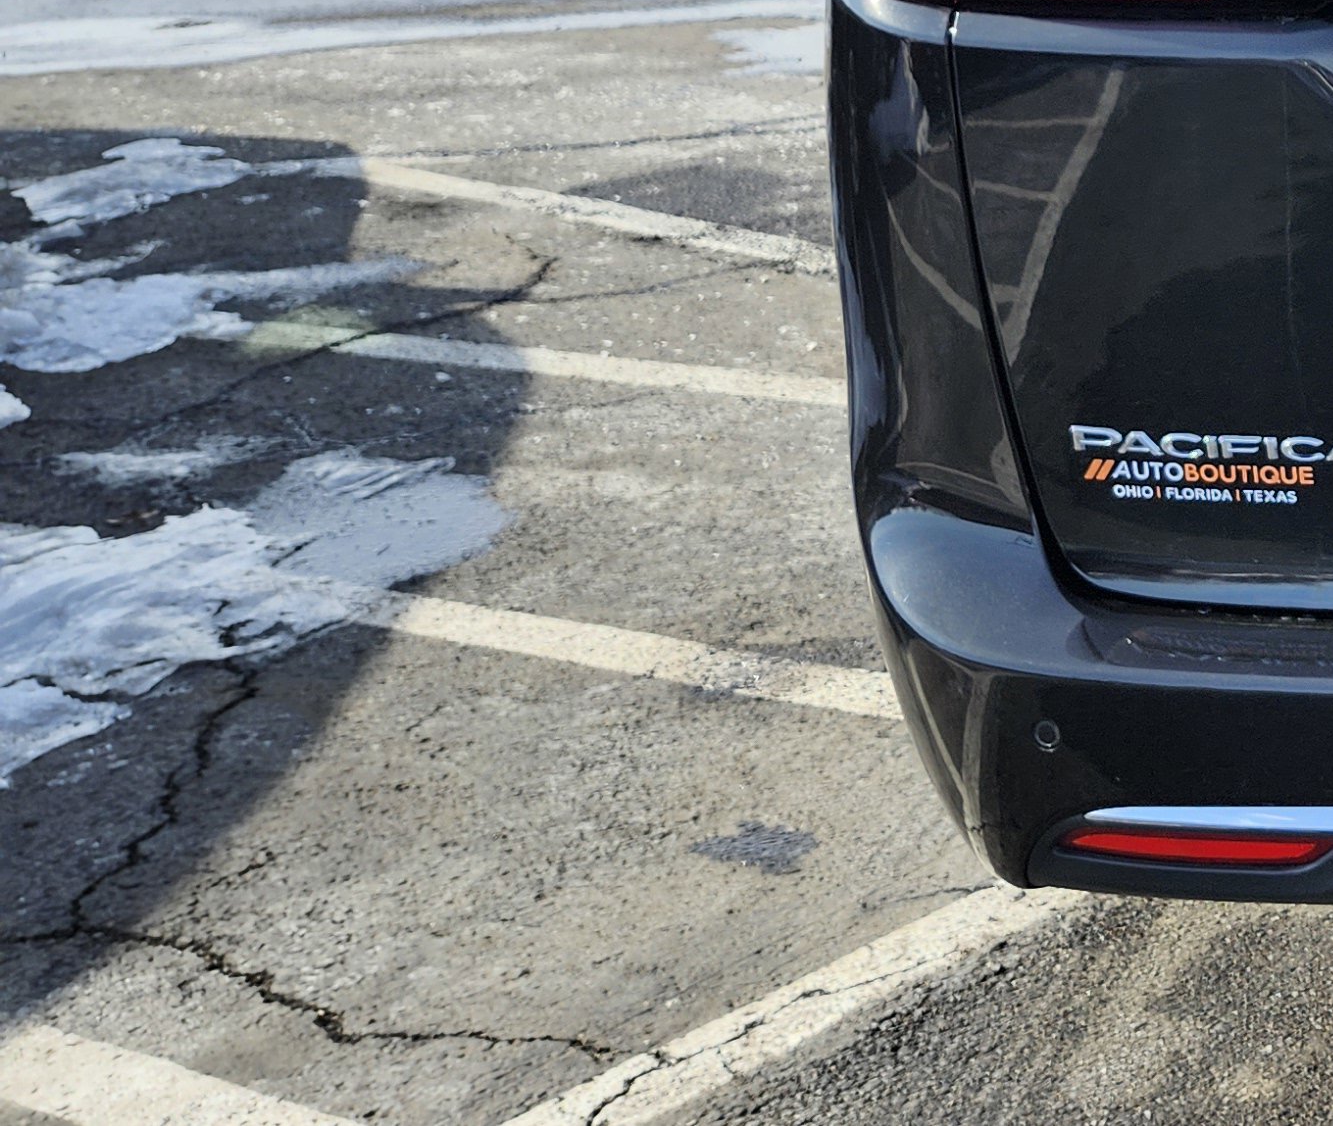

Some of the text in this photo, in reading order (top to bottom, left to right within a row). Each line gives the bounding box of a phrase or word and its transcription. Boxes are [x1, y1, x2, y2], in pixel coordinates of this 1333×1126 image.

[1112, 459, 1315, 486] AUTOBOUTIQUE
[1112, 484, 1154, 500] OHIO
[1164, 485, 1233, 503] FLORIDA
[1243, 489, 1298, 505] TEXAS
